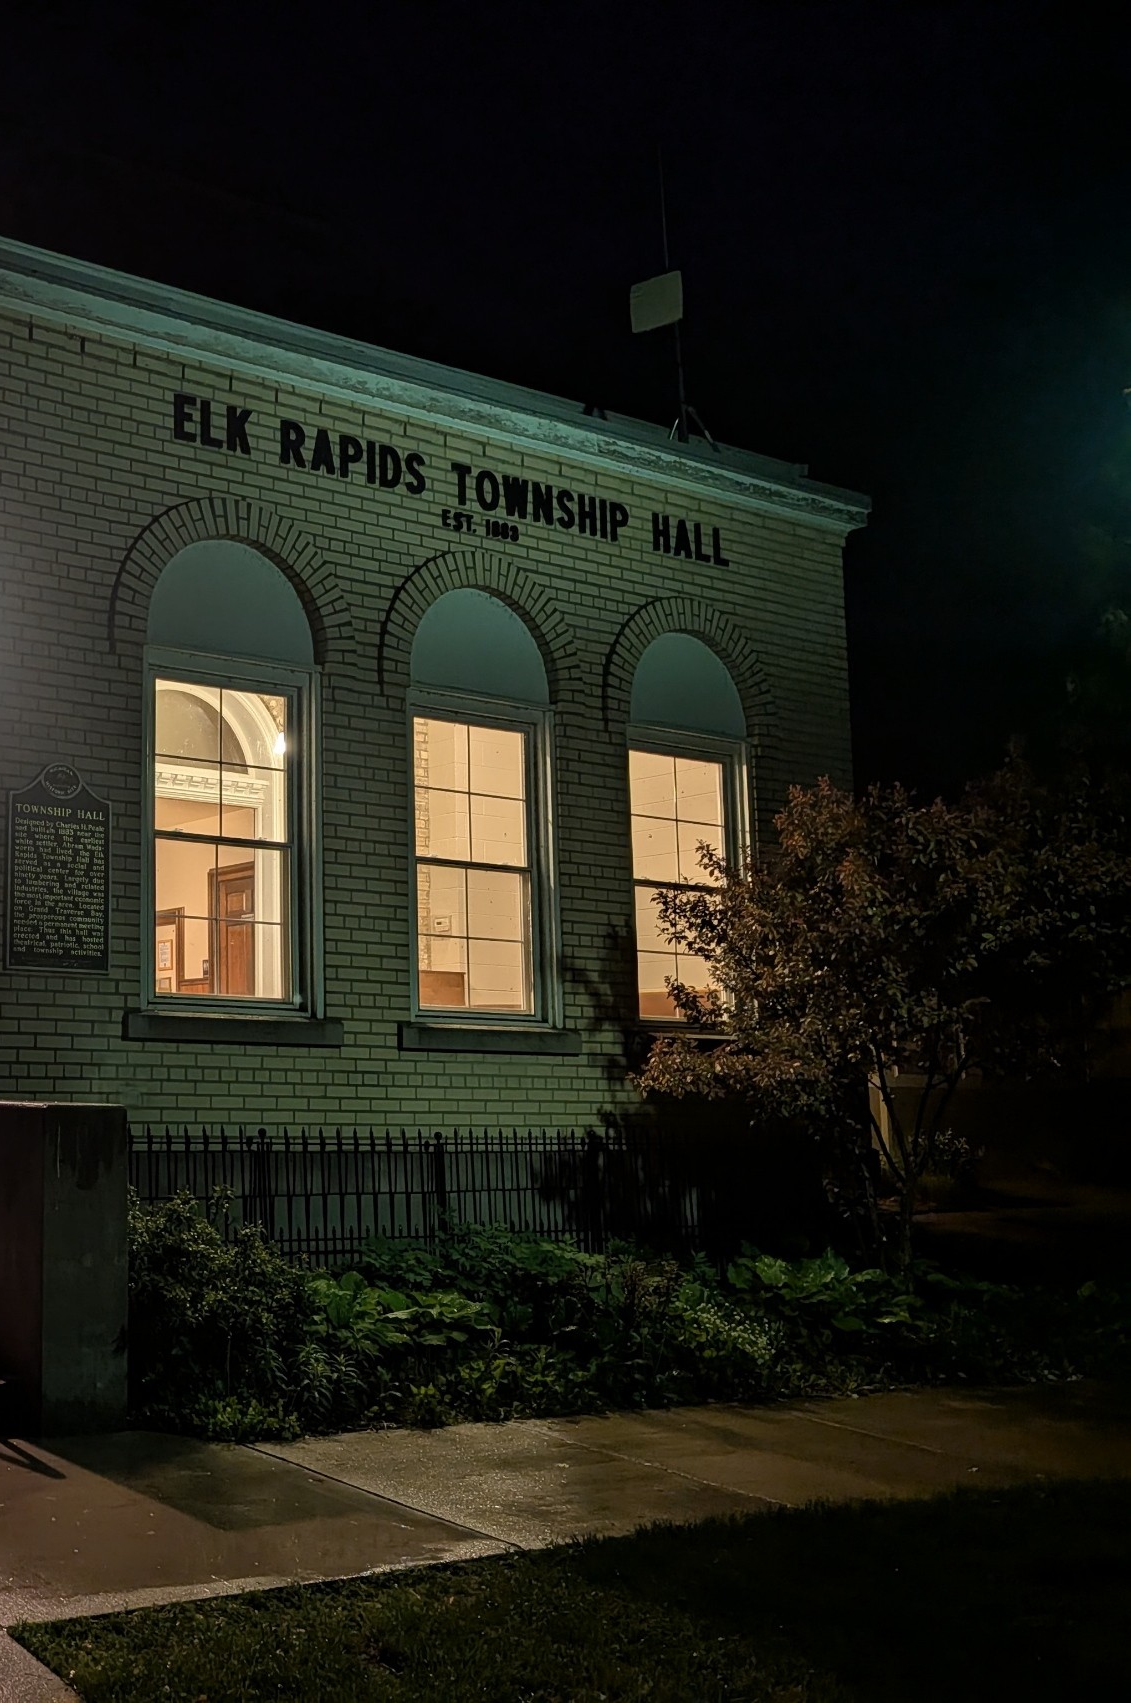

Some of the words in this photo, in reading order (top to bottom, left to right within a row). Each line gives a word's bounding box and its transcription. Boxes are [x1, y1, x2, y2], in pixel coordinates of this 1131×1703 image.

[173, 393, 253, 455] ELK
[279, 419, 427, 495] RAPIDS
[451, 463, 628, 543] TOWNSHIP
[652, 513, 729, 567] HALL
[441, 509, 477, 533] EST.
[16, 804, 71, 817] TOWNSHIP
[78, 810, 105, 820] HALL
